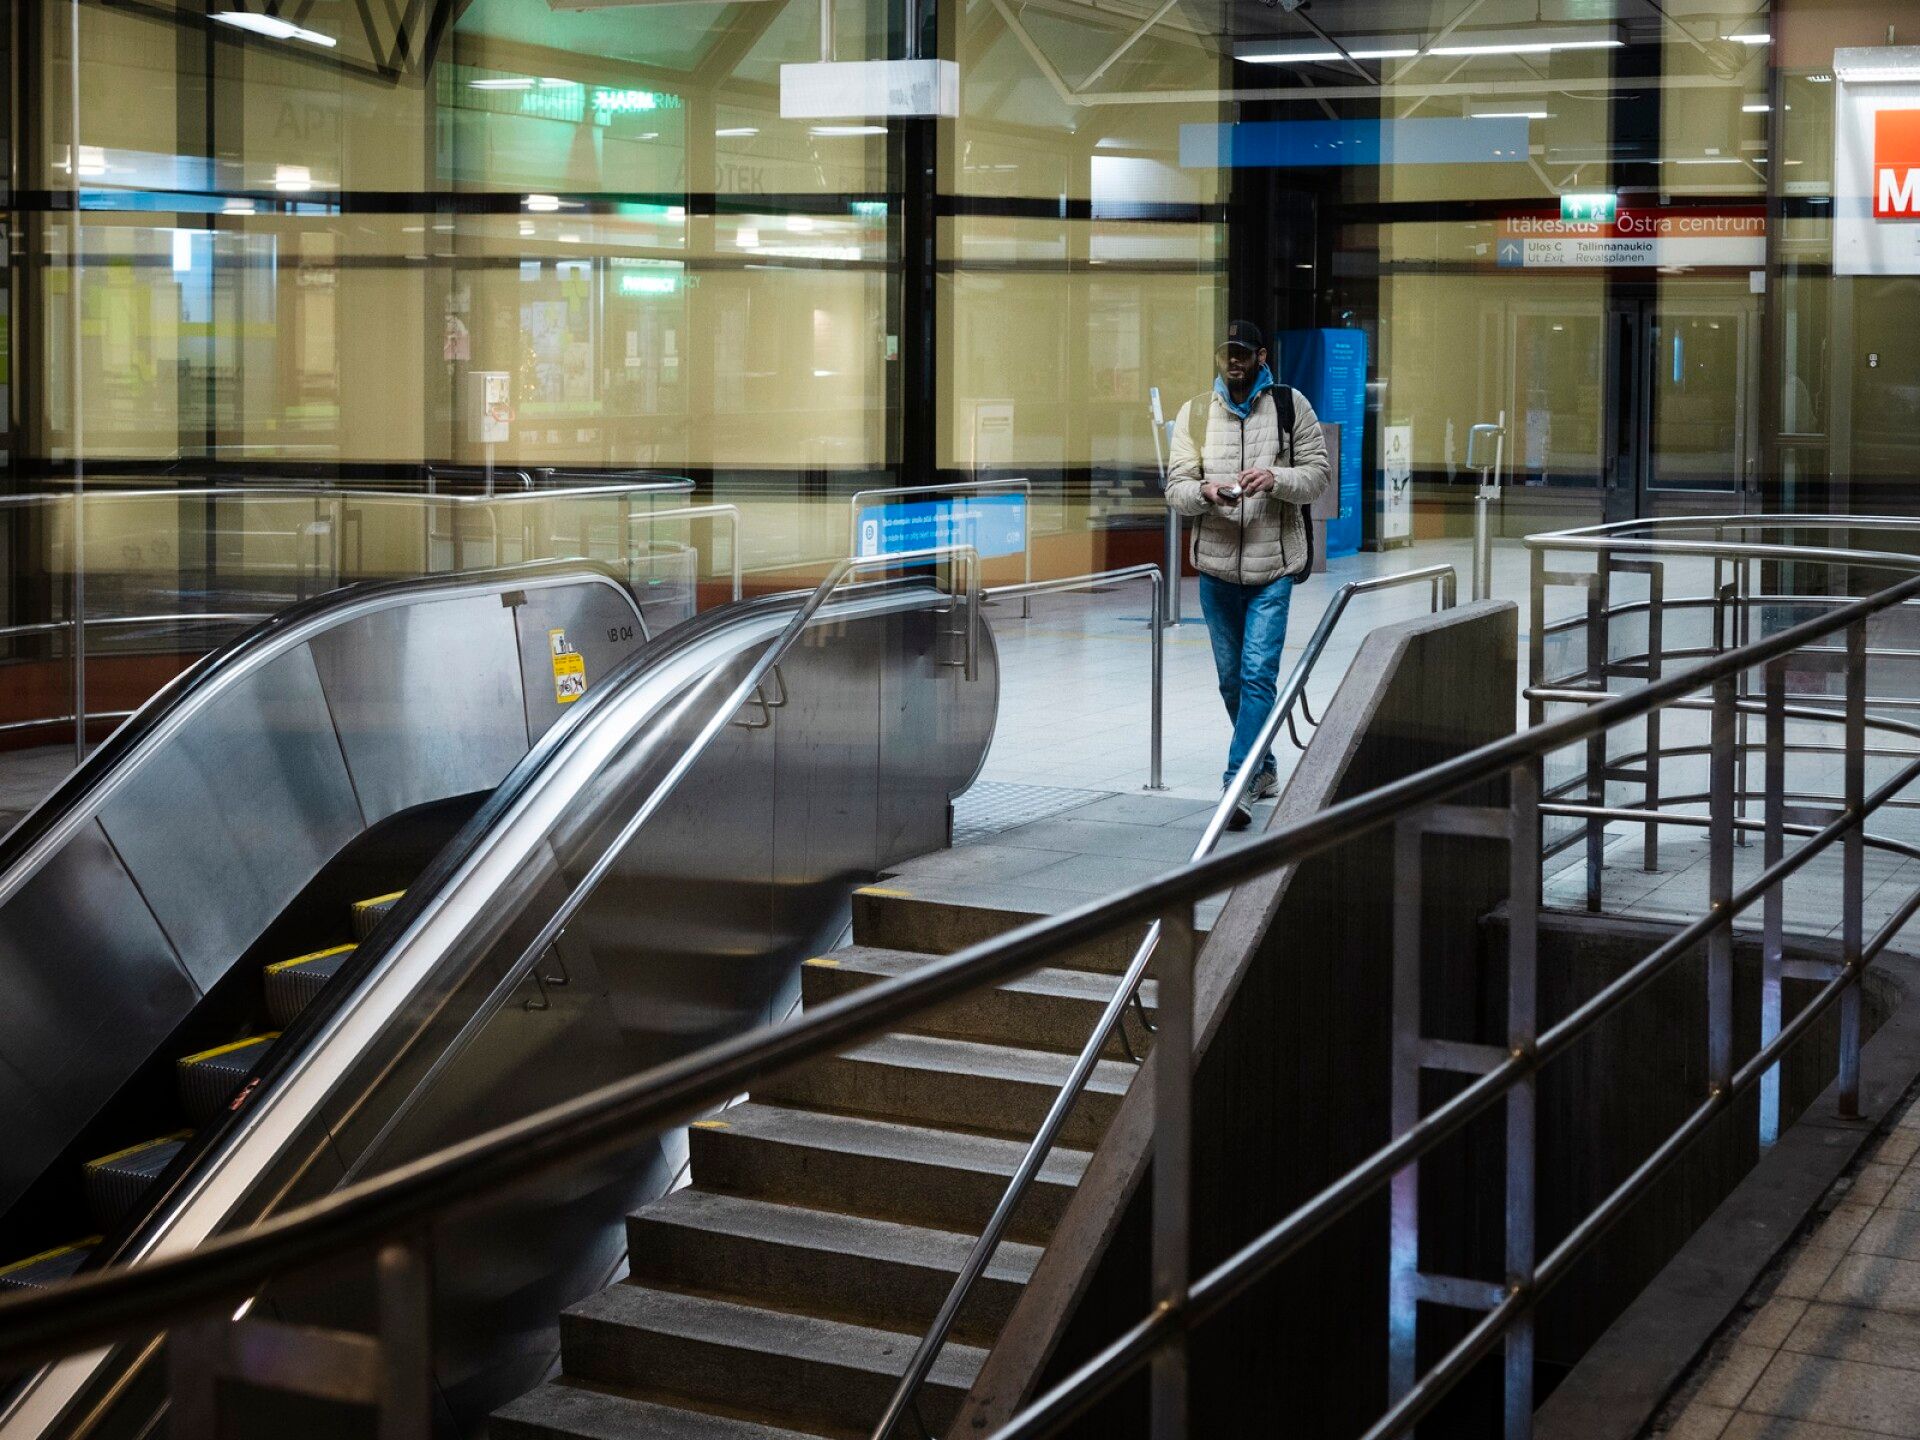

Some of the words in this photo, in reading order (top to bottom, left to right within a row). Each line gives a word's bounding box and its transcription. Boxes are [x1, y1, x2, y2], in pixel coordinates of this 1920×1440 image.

[1878, 168, 1920, 212] M
[1506, 214, 1599, 233] Itäkeskus
[1617, 211, 1673, 233] Östra
[1678, 215, 1766, 232] centrum
[1528, 241, 1551, 252] Ulos
[1554, 242, 1563, 252] C
[1576, 241, 1653, 252] Tallinnanaukio
[1528, 252, 1540, 263] Ut
[1544, 252, 1565, 263] Exit
[1576, 252, 1645, 264] Revalsplanen
